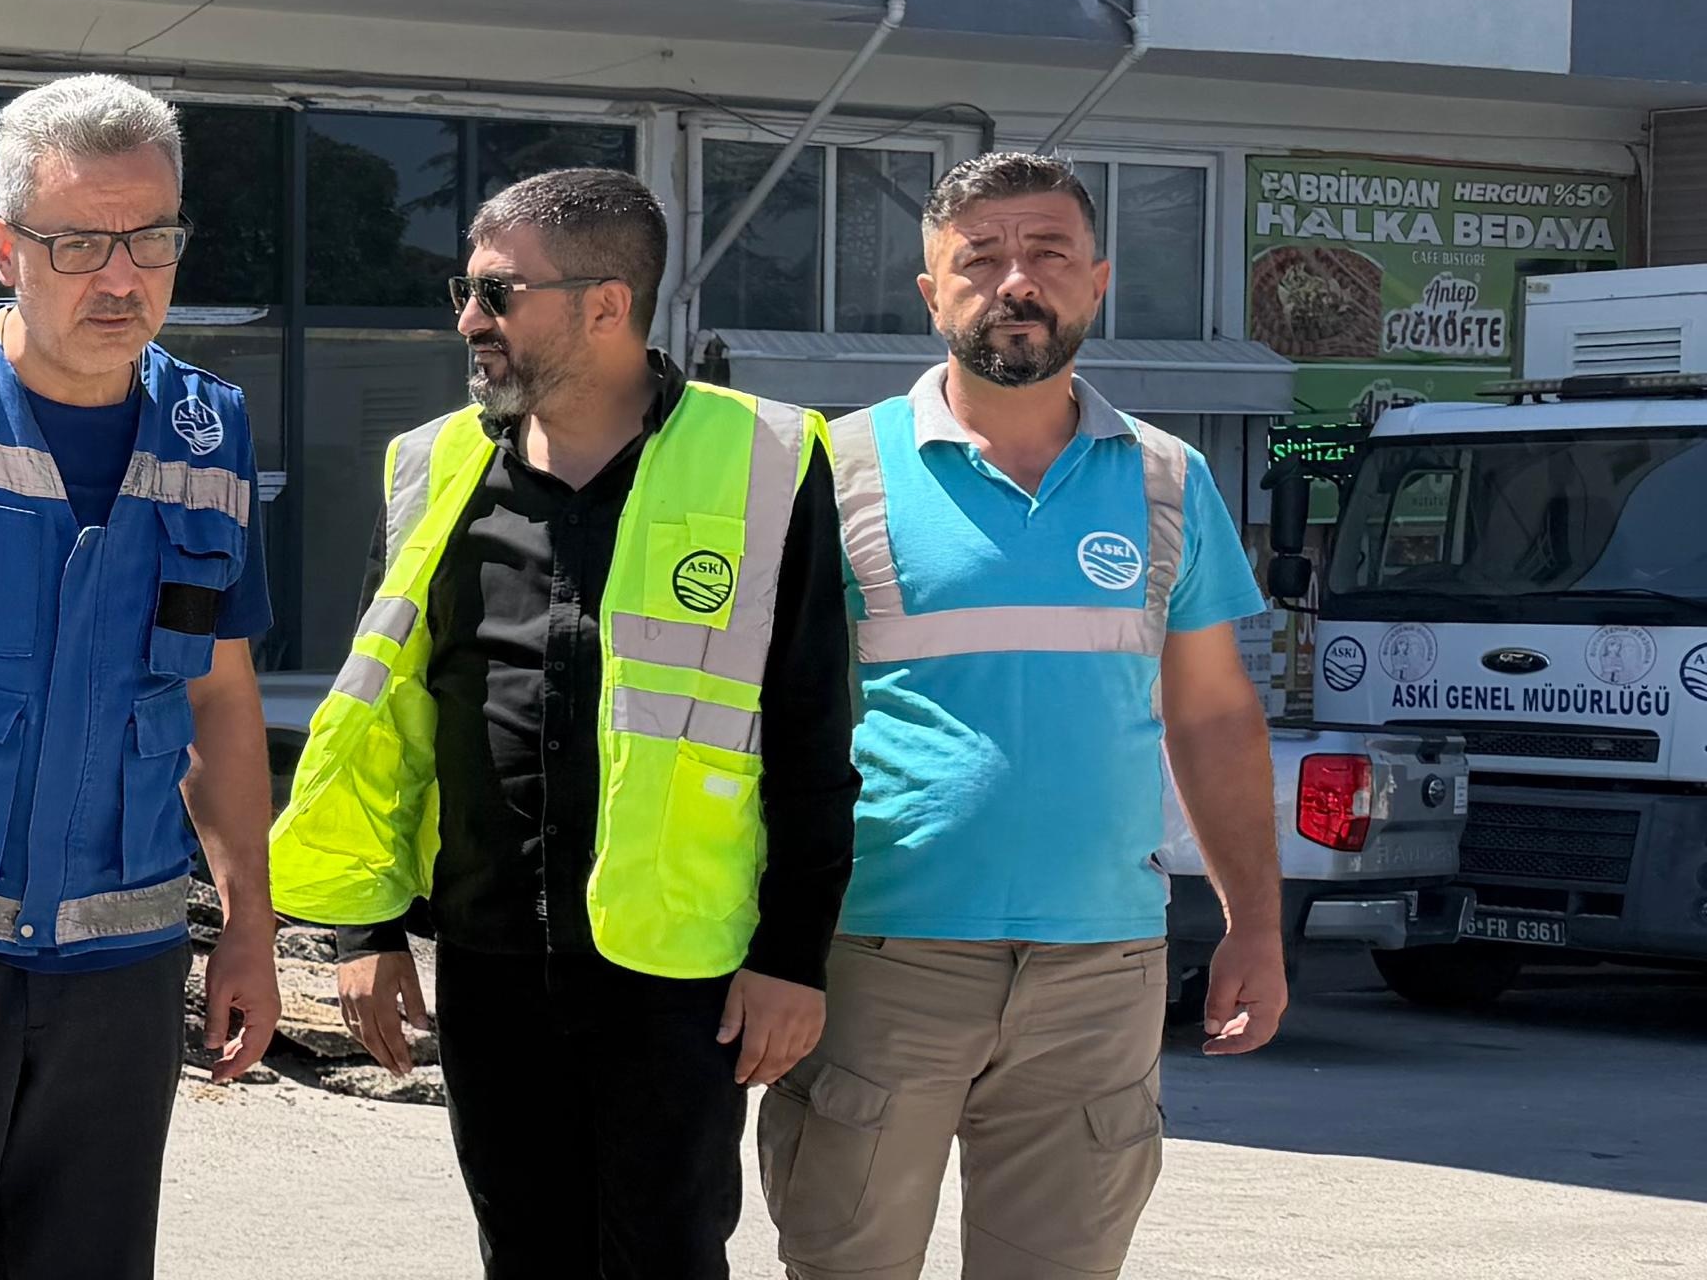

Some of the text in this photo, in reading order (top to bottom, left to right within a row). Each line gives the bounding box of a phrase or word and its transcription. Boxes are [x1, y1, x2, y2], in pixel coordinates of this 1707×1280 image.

[1260, 168, 1441, 209] FABRİKADAN
[1553, 183, 1614, 208] %50
[1255, 202, 1616, 251] HALKA BEDAYA
[1425, 279, 1477, 312] Antep
[1392, 679, 1670, 717] ASKİ GENEL MÜDÜRLÜĞÜ
[1487, 920, 1507, 938] FR
[1517, 920, 1561, 943] 6361
